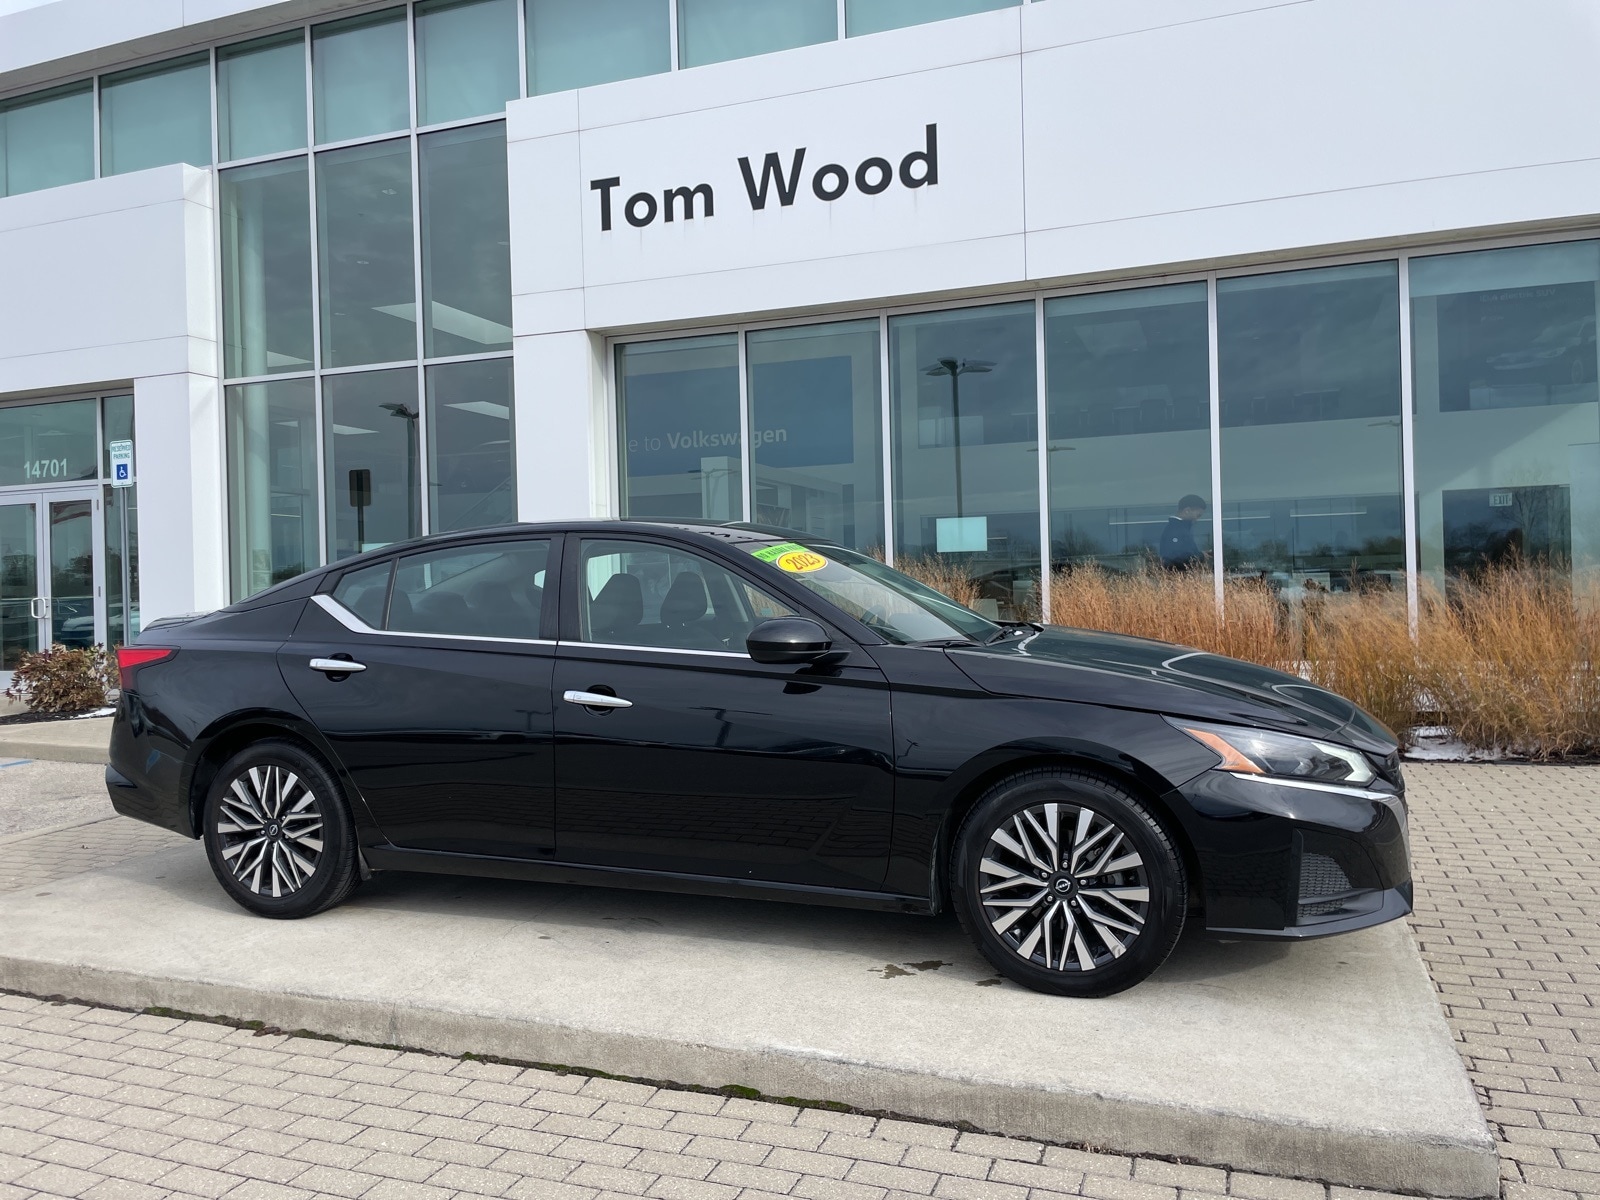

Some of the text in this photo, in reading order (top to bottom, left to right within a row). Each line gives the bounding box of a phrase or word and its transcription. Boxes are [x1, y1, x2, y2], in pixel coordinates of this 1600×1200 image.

[590, 123, 939, 232] Tom Wood
[1536, 288, 1557, 297] SUV
[643, 436, 661, 452] to
[667, 428, 787, 450] Volkswgen
[23, 458, 67, 479] 14701
[1493, 494, 1509, 505] EXIT
[786, 553, 821, 570] 2023
